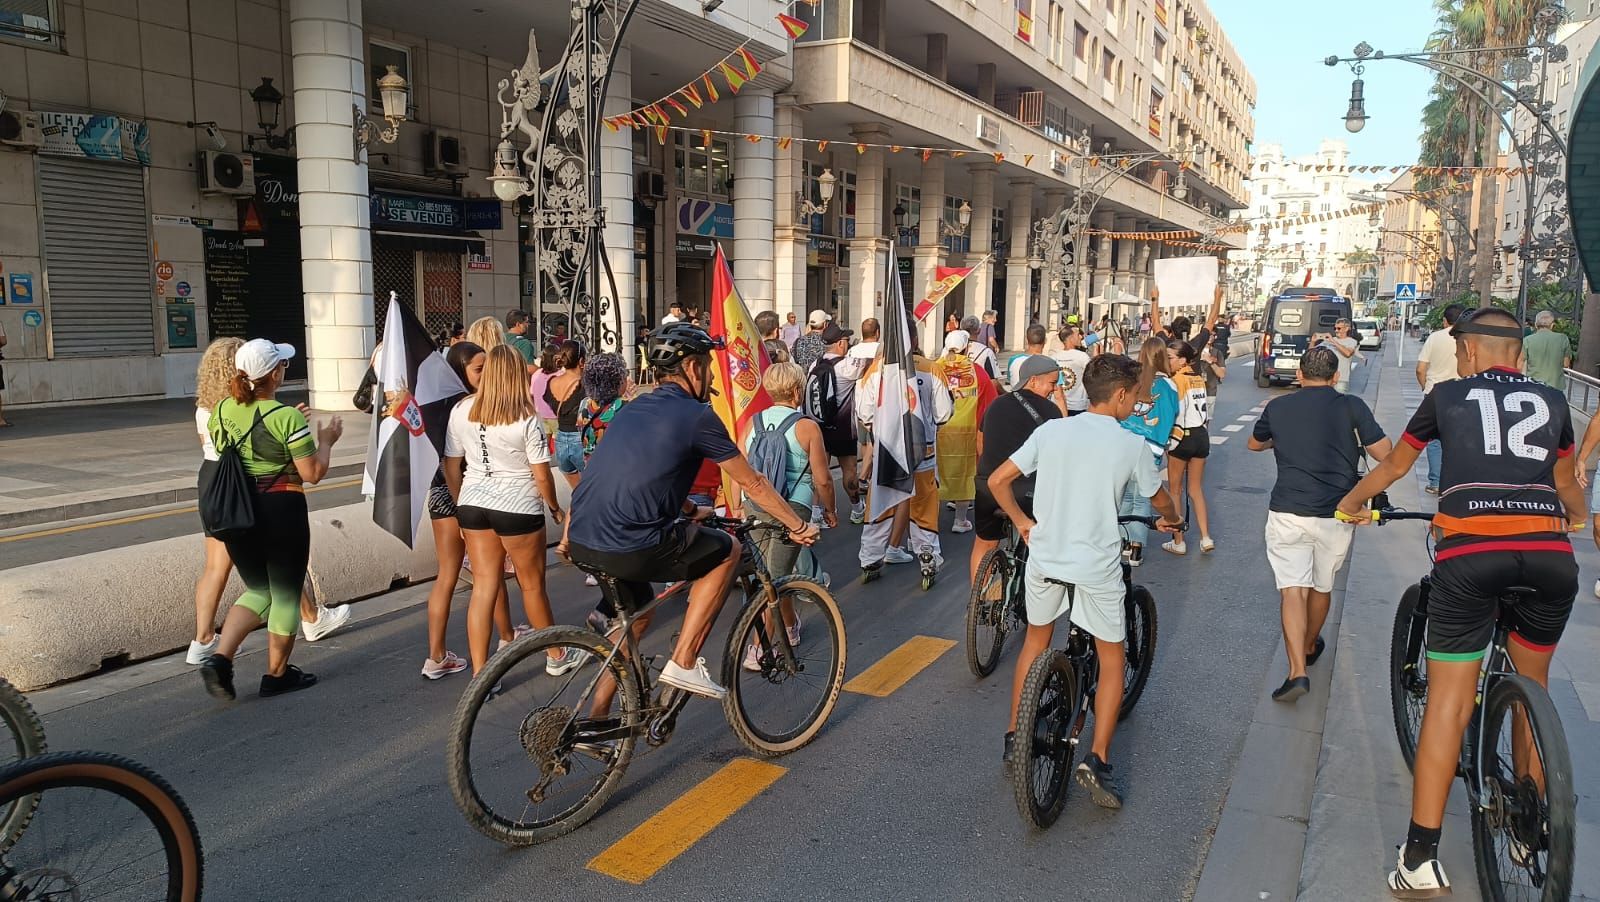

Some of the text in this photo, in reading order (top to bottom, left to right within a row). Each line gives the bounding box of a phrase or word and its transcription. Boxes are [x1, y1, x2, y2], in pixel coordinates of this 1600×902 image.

[390, 209, 452, 225] SE VENDE
[158, 264, 172, 274] ria
[1465, 388, 1550, 461] 12
[1468, 500, 1506, 510] DIMA
